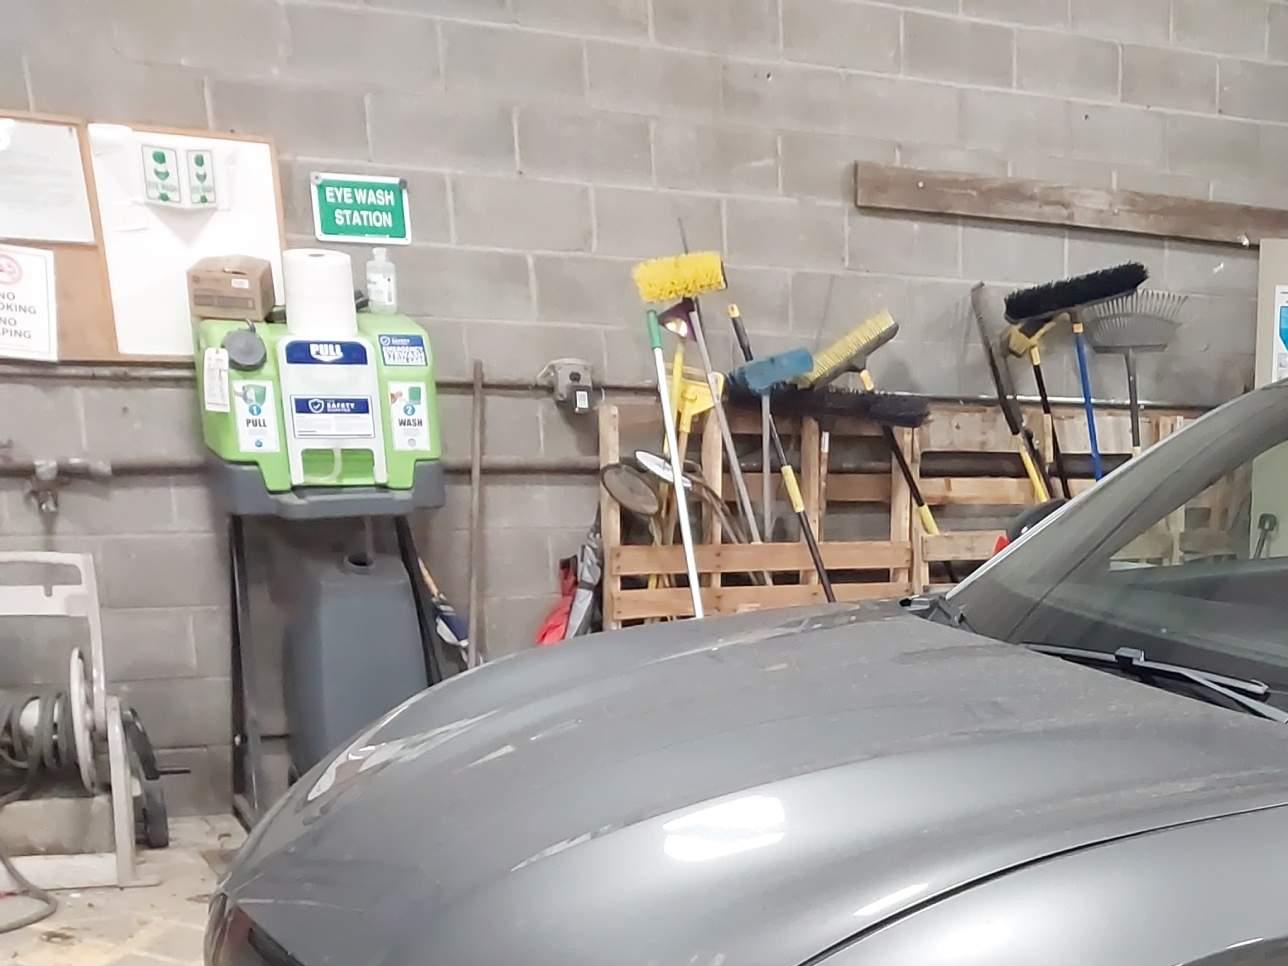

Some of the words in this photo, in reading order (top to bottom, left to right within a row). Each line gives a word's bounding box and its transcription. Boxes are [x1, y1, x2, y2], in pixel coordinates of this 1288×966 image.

[325, 186, 353, 204] EYE
[354, 188, 394, 206] WASH
[334, 208, 393, 227] STATION
[0, 301, 37, 314] OKING
[0, 327, 32, 339] PING
[309, 343, 343, 357] PULL
[246, 418, 267, 427] PULL
[398, 418, 423, 427] WASH
